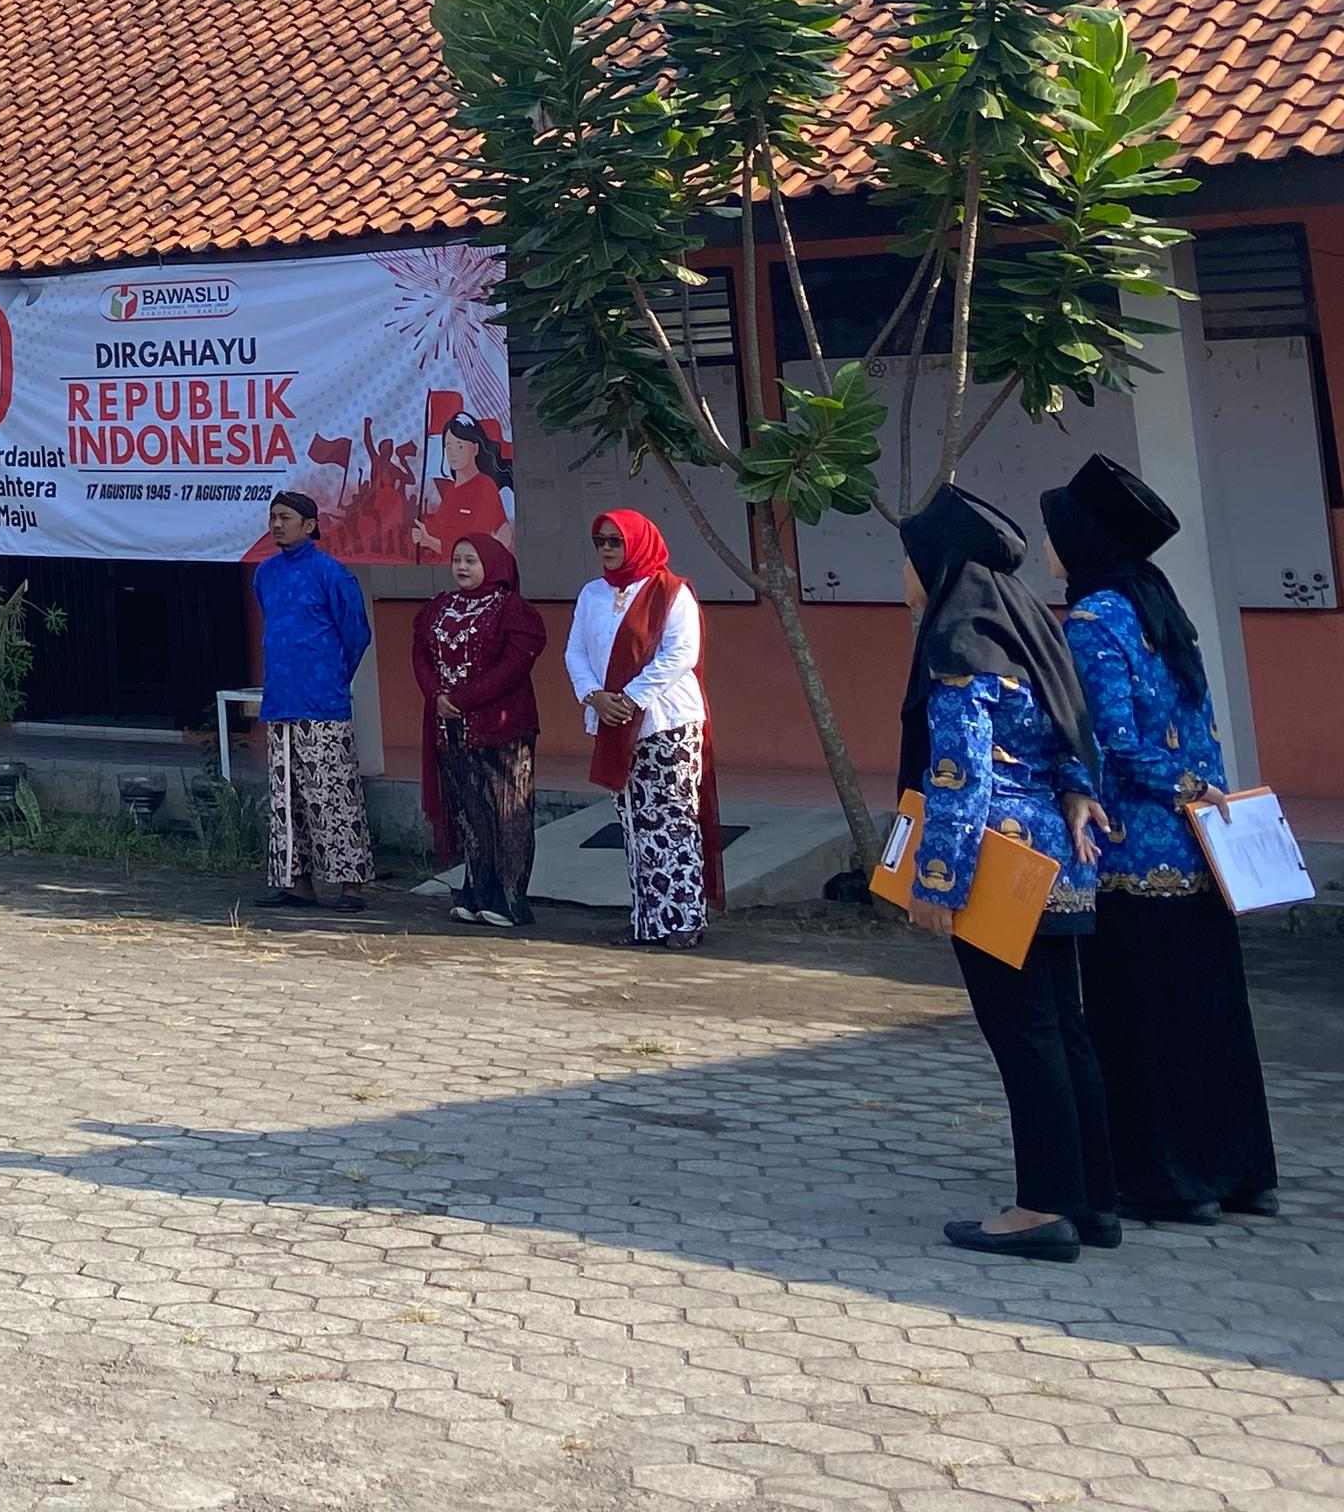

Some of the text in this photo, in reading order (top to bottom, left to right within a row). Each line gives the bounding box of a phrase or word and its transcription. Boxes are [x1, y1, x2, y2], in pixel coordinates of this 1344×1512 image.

[143, 286, 230, 305] BAWASLU
[96, 337, 256, 368] DIRGAHAYU
[68, 378, 296, 421] REPUBLIK
[68, 424, 297, 465] INDONESIA
[86, 484, 97, 500] 17
[99, 484, 143, 500] AGUSTUS
[146, 484, 172, 500] 1945
[180, 485, 193, 501] 17
[195, 485, 241, 501] AGUSTUS
[243, 485, 273, 502] 2025
